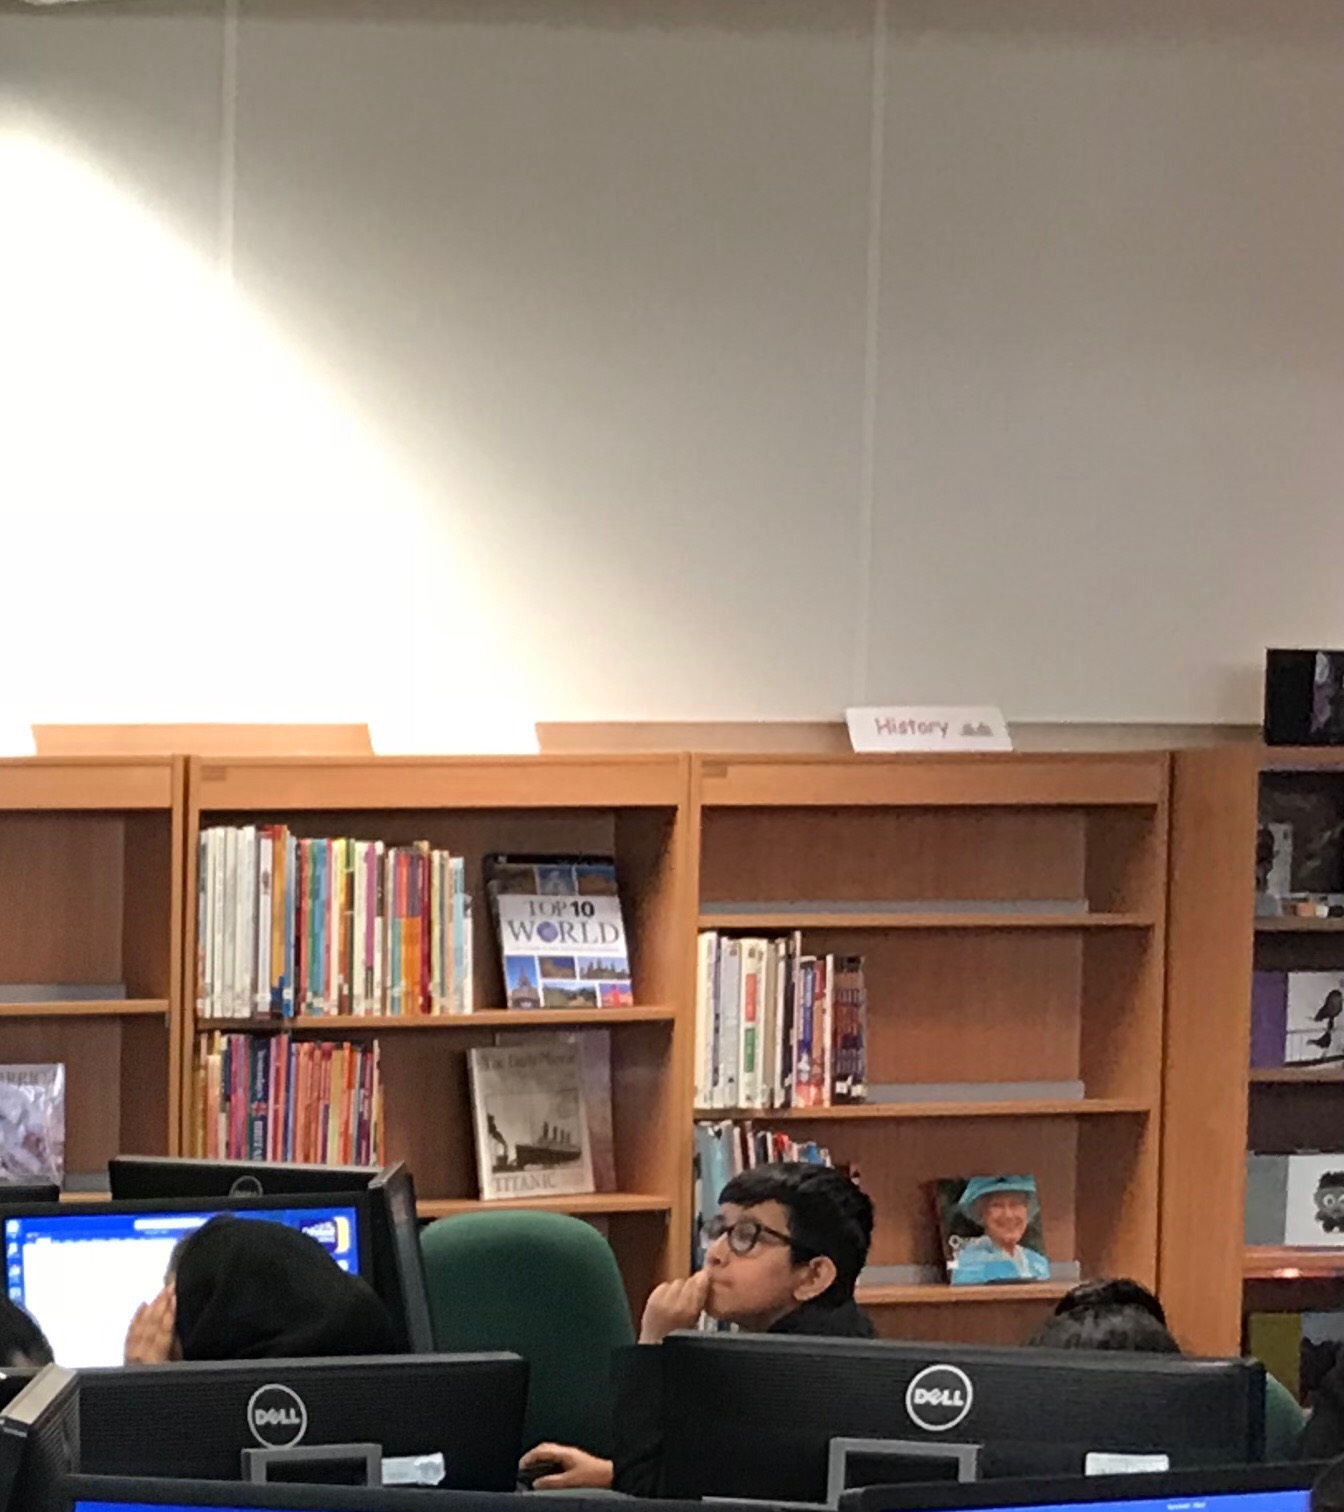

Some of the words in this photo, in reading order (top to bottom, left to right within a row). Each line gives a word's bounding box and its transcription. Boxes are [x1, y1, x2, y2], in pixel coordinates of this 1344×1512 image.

[874, 718, 948, 738] History
[527, 900, 567, 917] TOP
[570, 900, 596, 918] 10
[508, 920, 620, 944] WORLD
[913, 1387, 964, 1406] DELL
[255, 1408, 301, 1426] DELL
